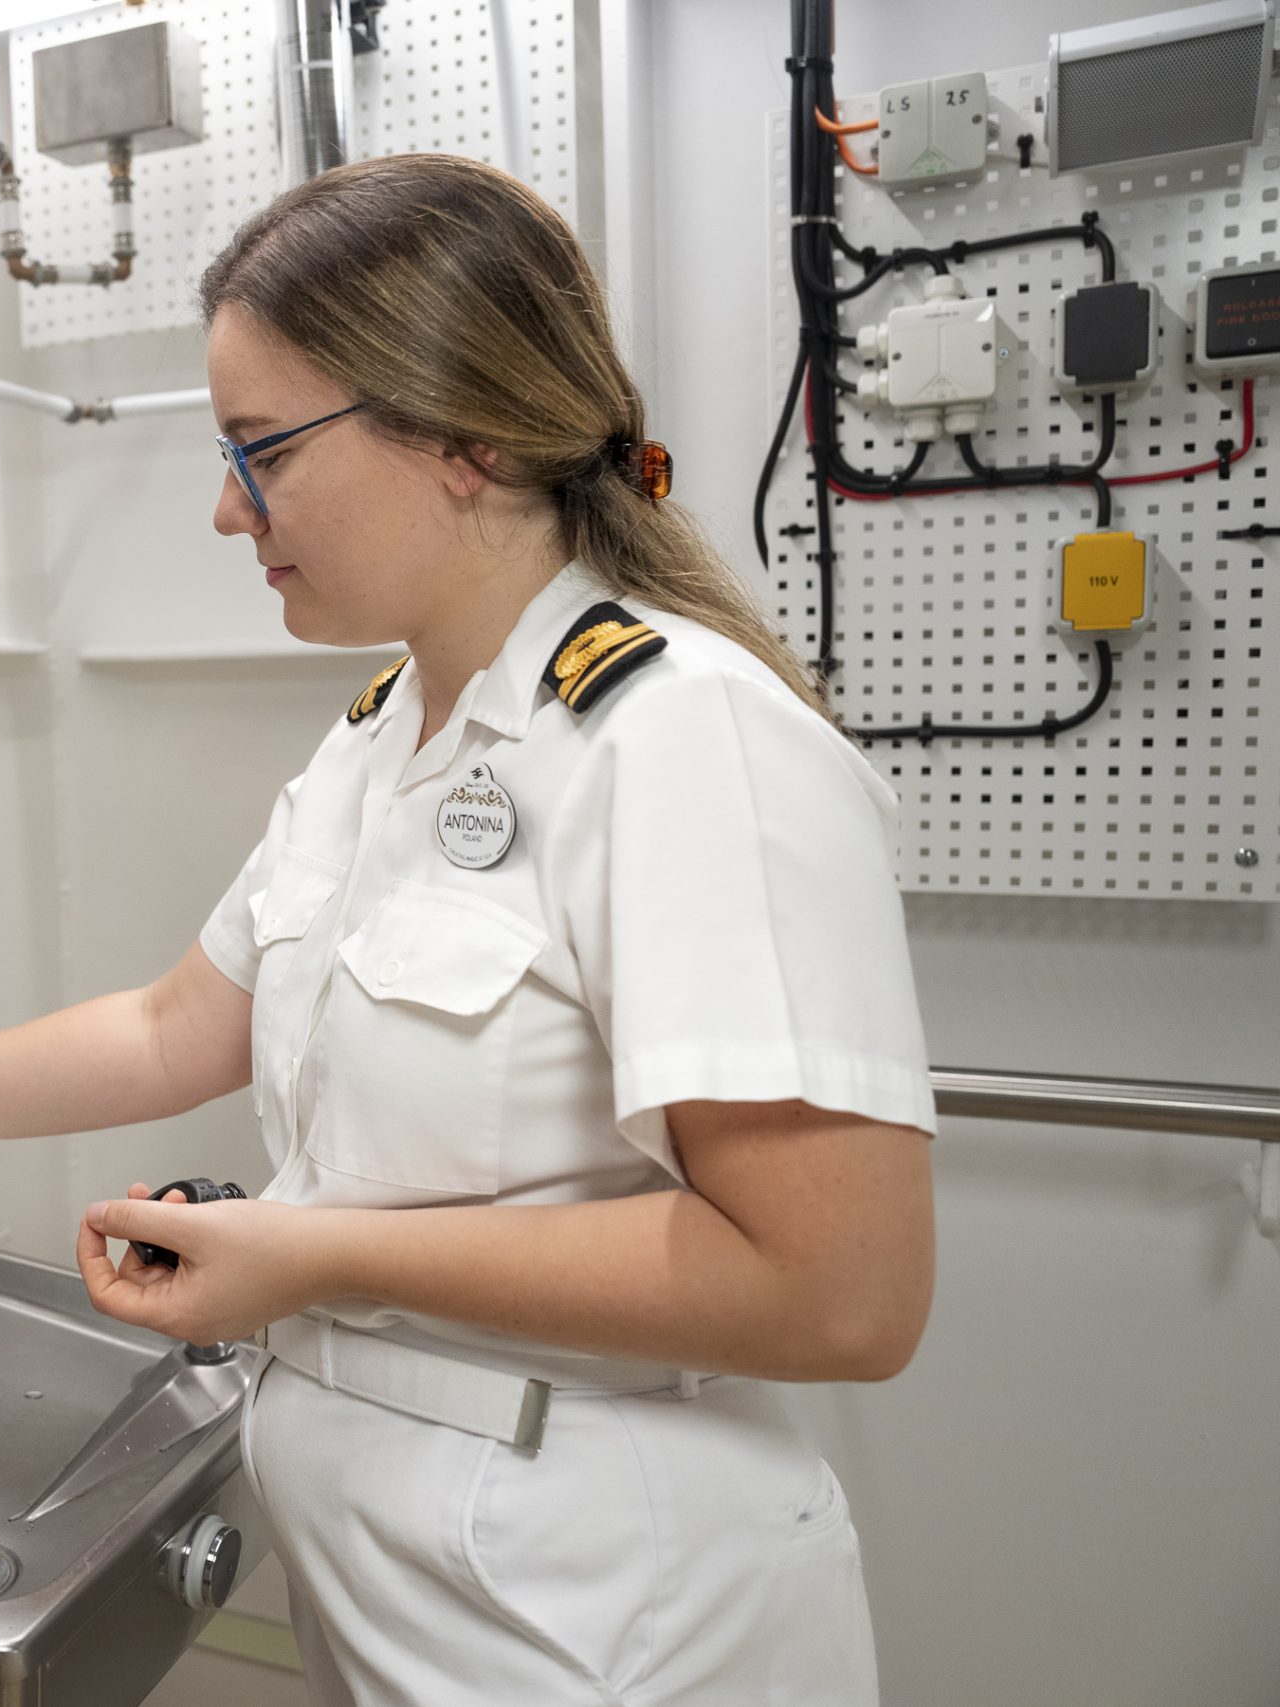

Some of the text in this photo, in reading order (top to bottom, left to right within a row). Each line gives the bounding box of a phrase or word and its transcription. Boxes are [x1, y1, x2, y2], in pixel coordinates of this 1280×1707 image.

[1089, 575, 1118, 587] 110 V
[444, 814, 504, 833] ANTONINA
